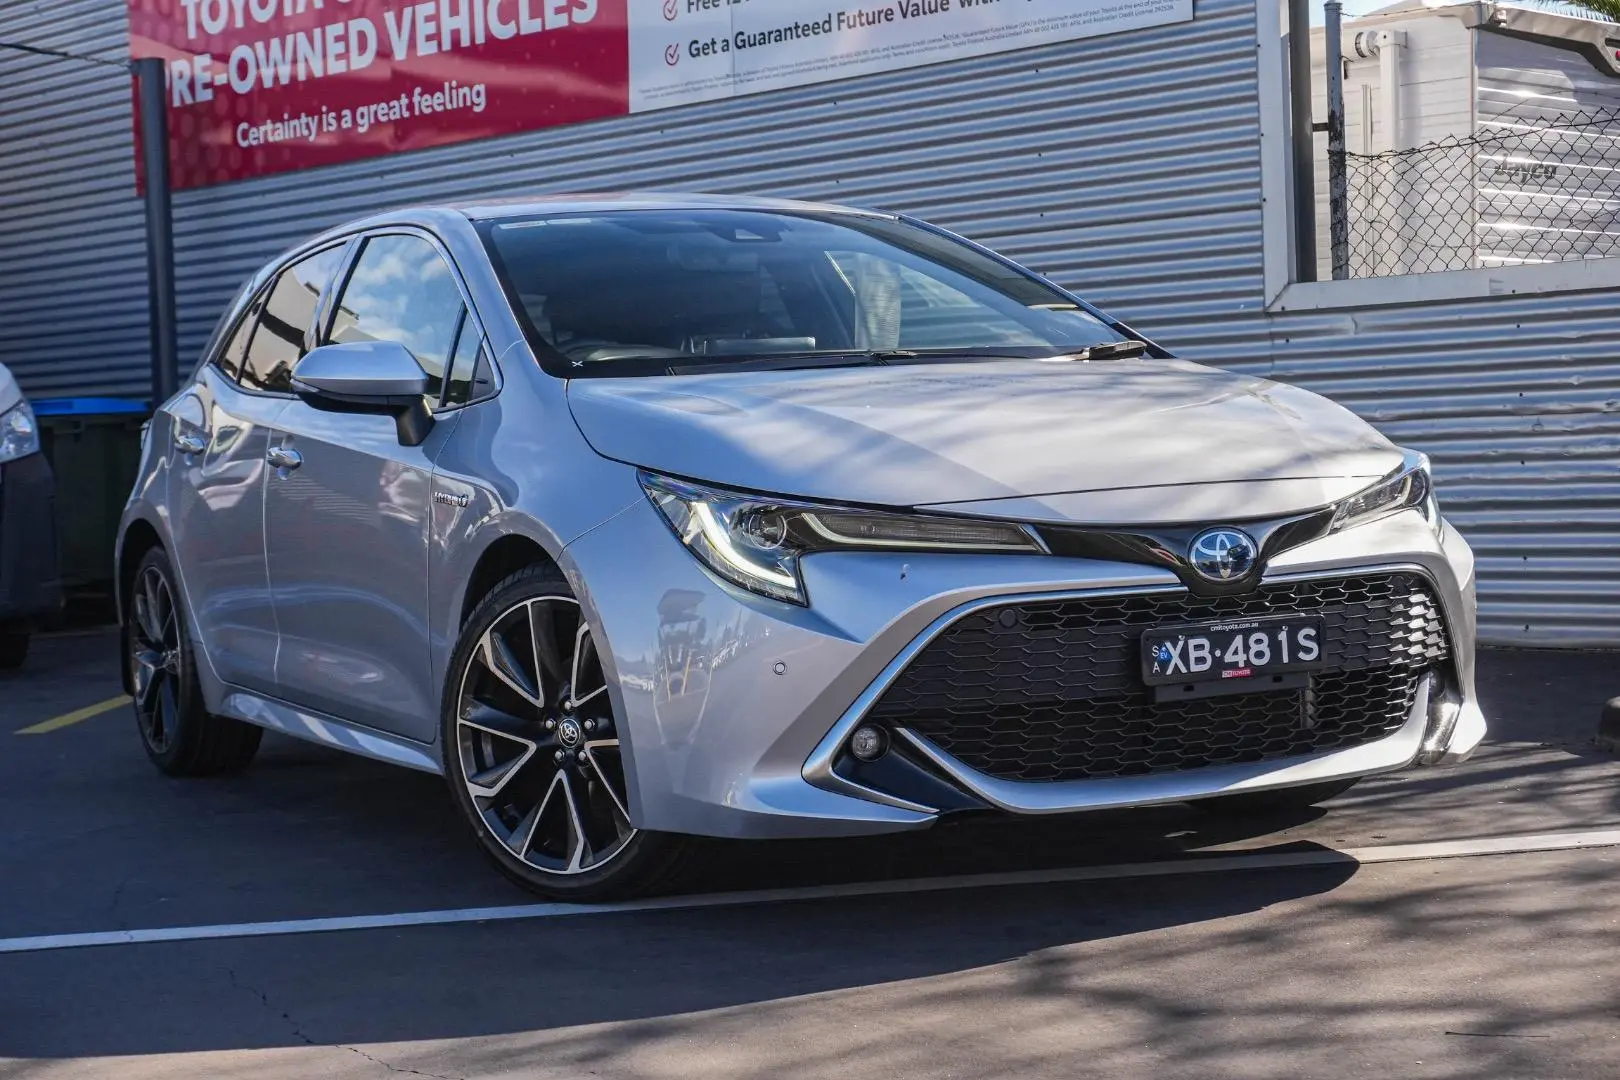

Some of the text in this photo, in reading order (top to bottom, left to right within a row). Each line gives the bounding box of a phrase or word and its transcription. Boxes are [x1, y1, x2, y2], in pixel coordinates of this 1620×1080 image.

[181, 0, 324, 39] TOYO
[688, 0, 950, 58] Get a Guaranteed Future Value
[165, 18, 377, 107] RE-OWNED
[236, 80, 486, 147] Certainty is a great feeling
[1160, 652, 1168, 660] EV
